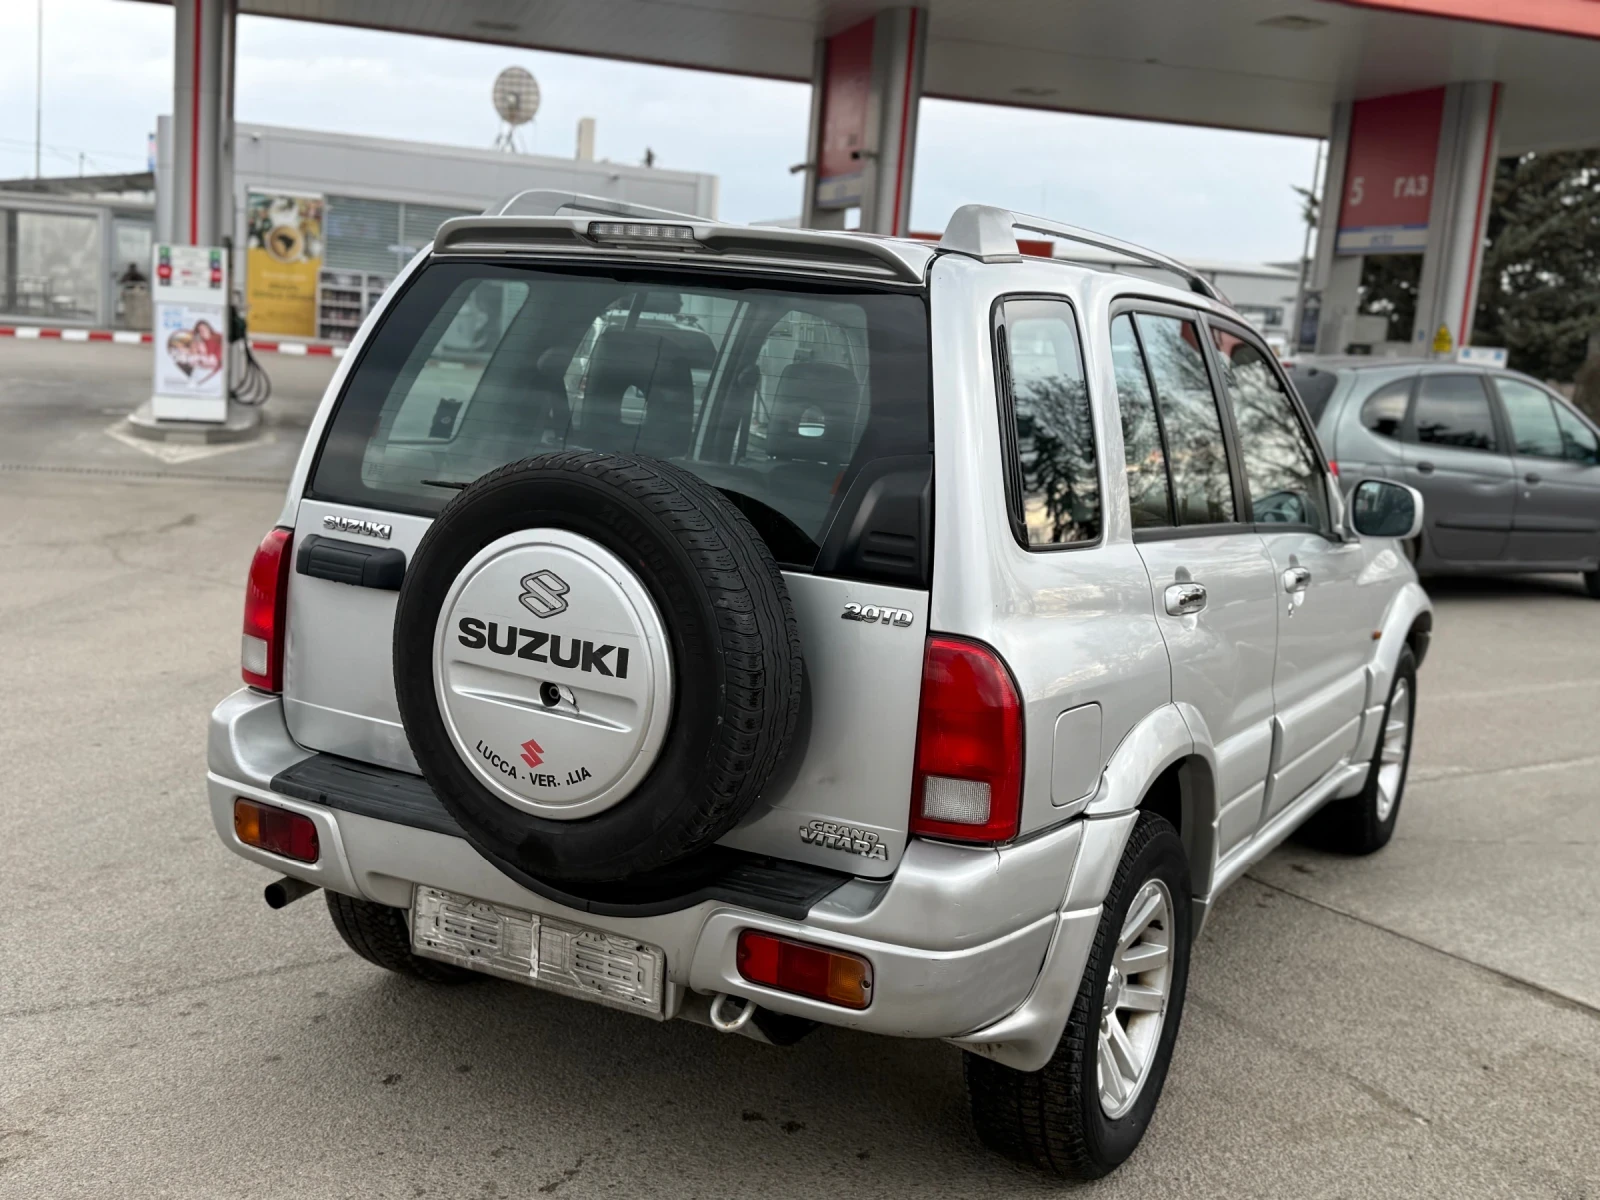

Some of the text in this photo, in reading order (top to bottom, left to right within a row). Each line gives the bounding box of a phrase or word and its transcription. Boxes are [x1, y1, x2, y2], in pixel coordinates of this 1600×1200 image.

[1349, 175, 1429, 206] 5 ГАЗ
[323, 515, 392, 540] SUZUKI
[458, 617, 629, 679] SUZUKI
[476, 740, 517, 779] LUCCA
[800, 826, 888, 860] VITARA
[809, 820, 879, 843] GRAND
